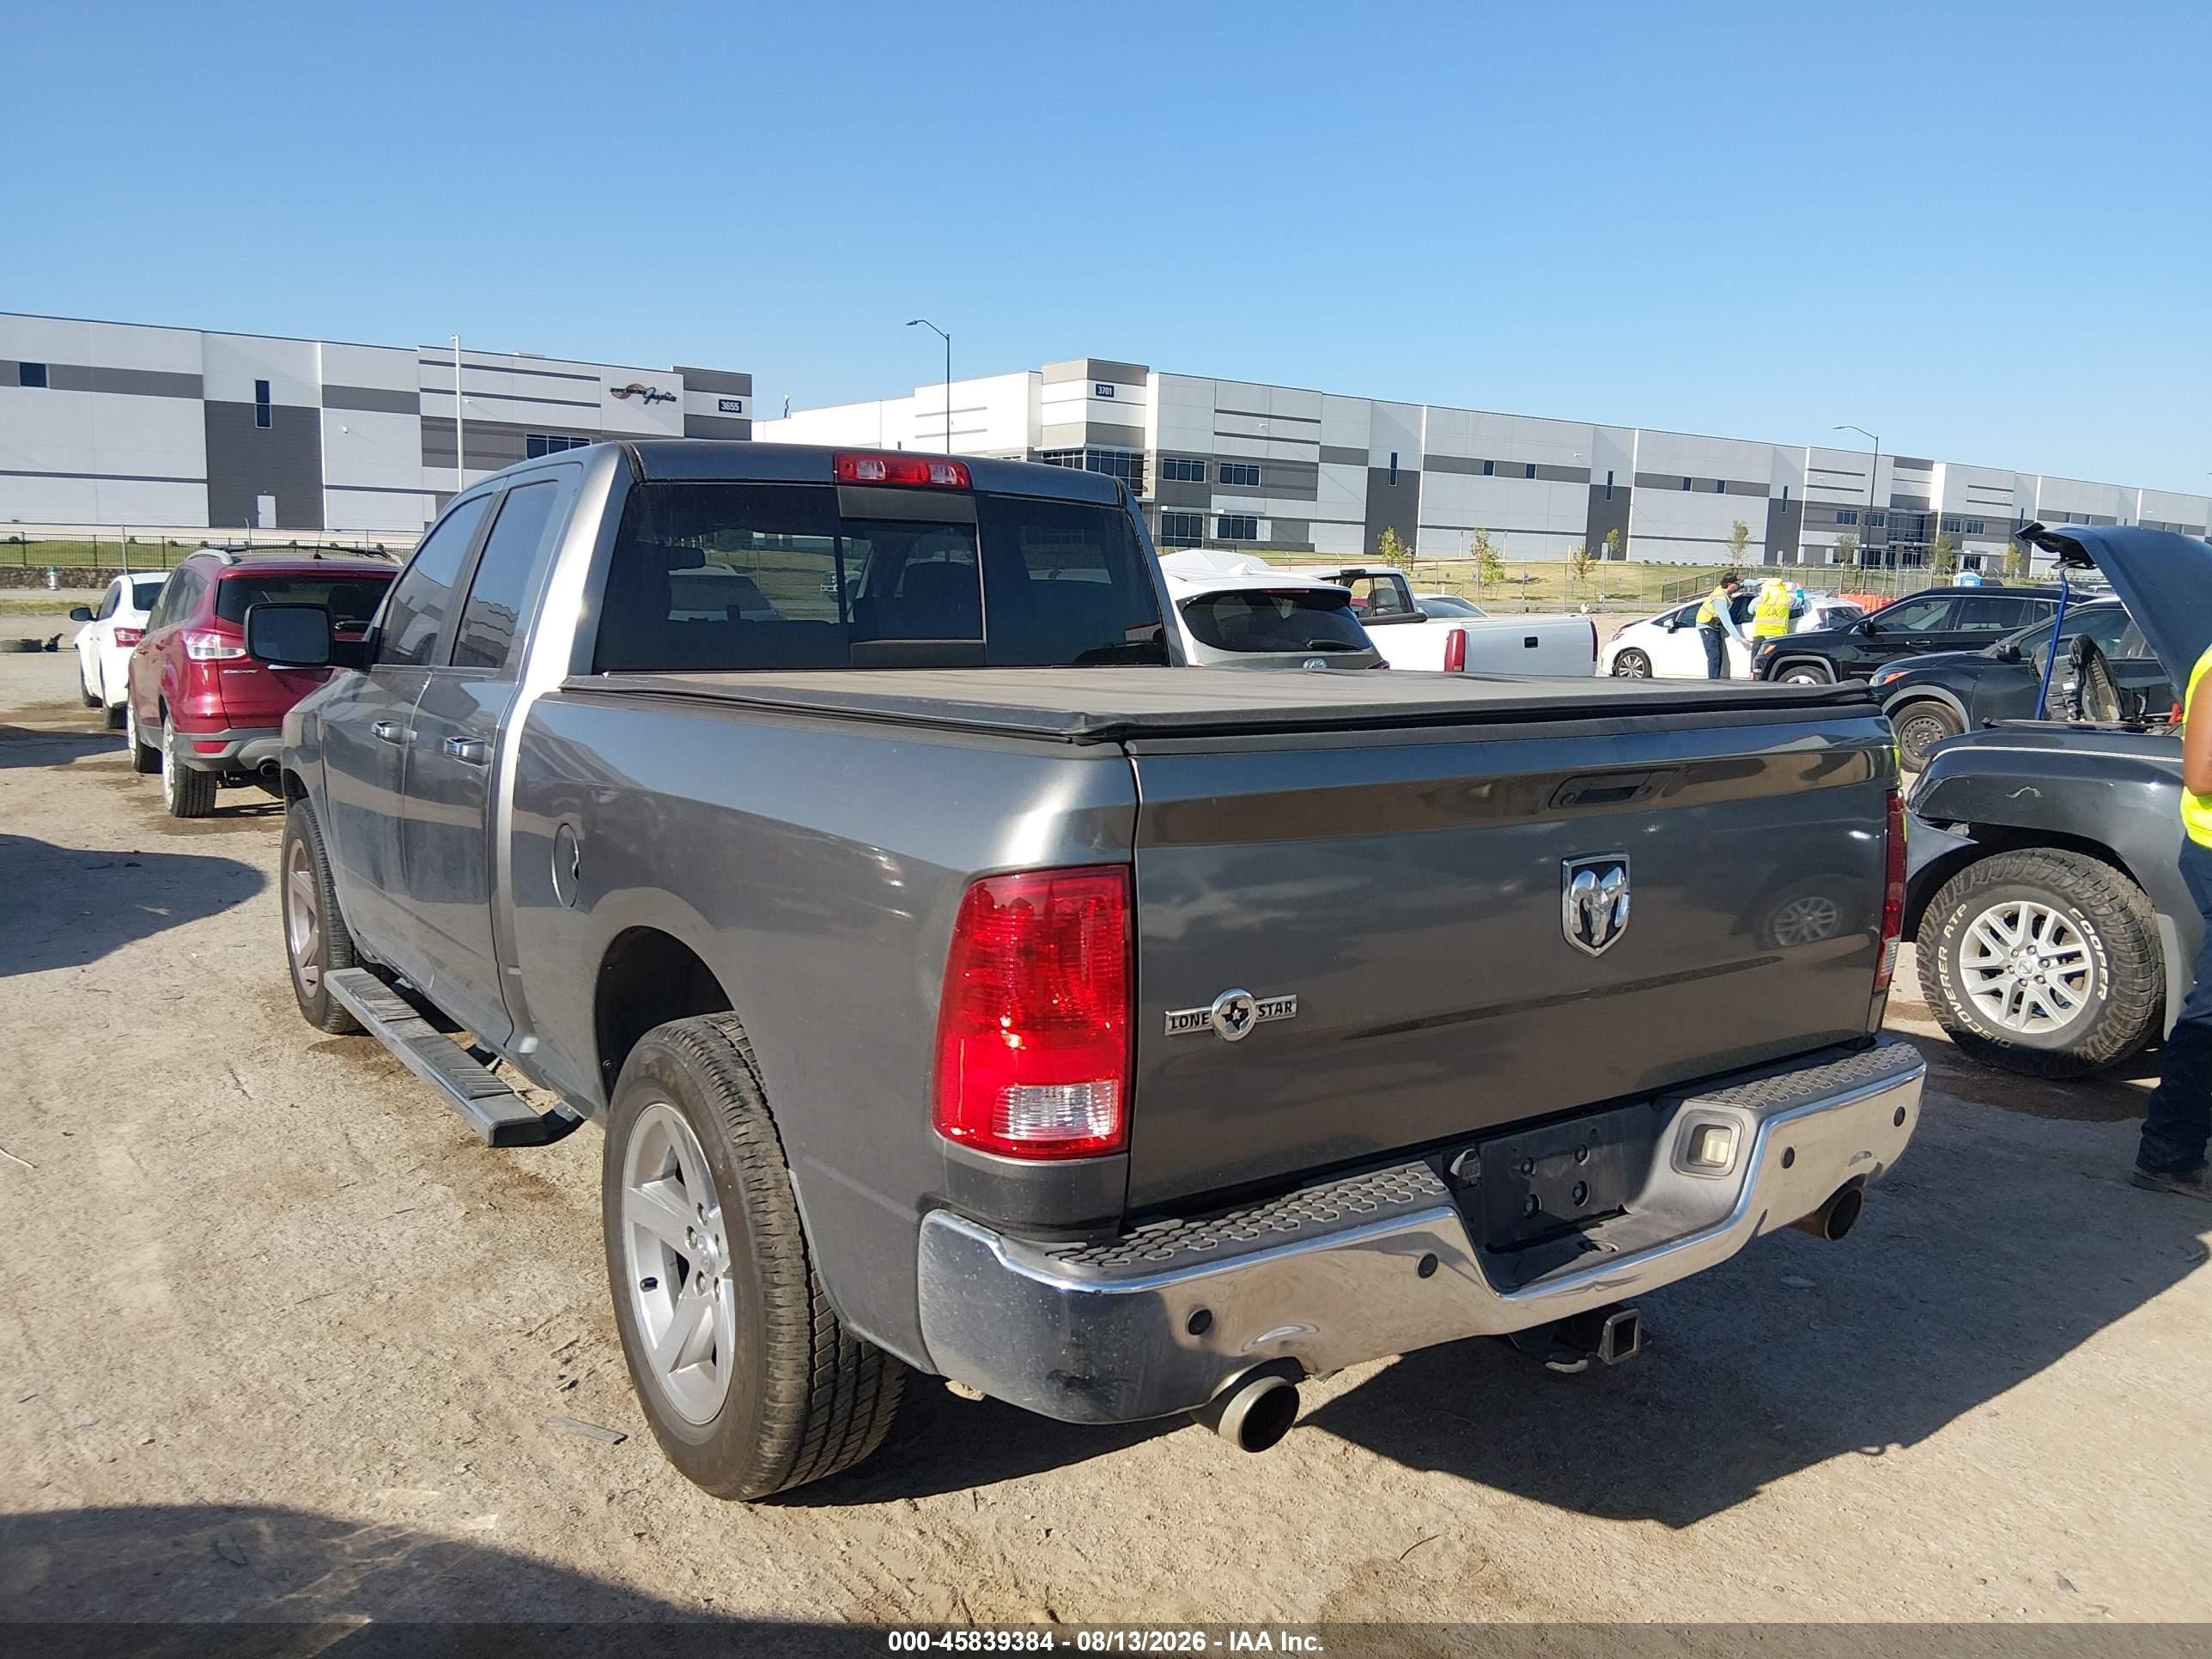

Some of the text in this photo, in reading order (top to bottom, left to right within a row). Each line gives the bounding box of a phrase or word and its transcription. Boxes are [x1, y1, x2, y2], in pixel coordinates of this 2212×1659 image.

[720, 400, 740, 411] 3655
[1097, 386, 1112, 396] 3701
[2069, 907, 2109, 1001] COOPER
[1937, 903, 2013, 1048] DISCOVERER ATP
[1170, 1000, 1293, 1030] LONE STAR
